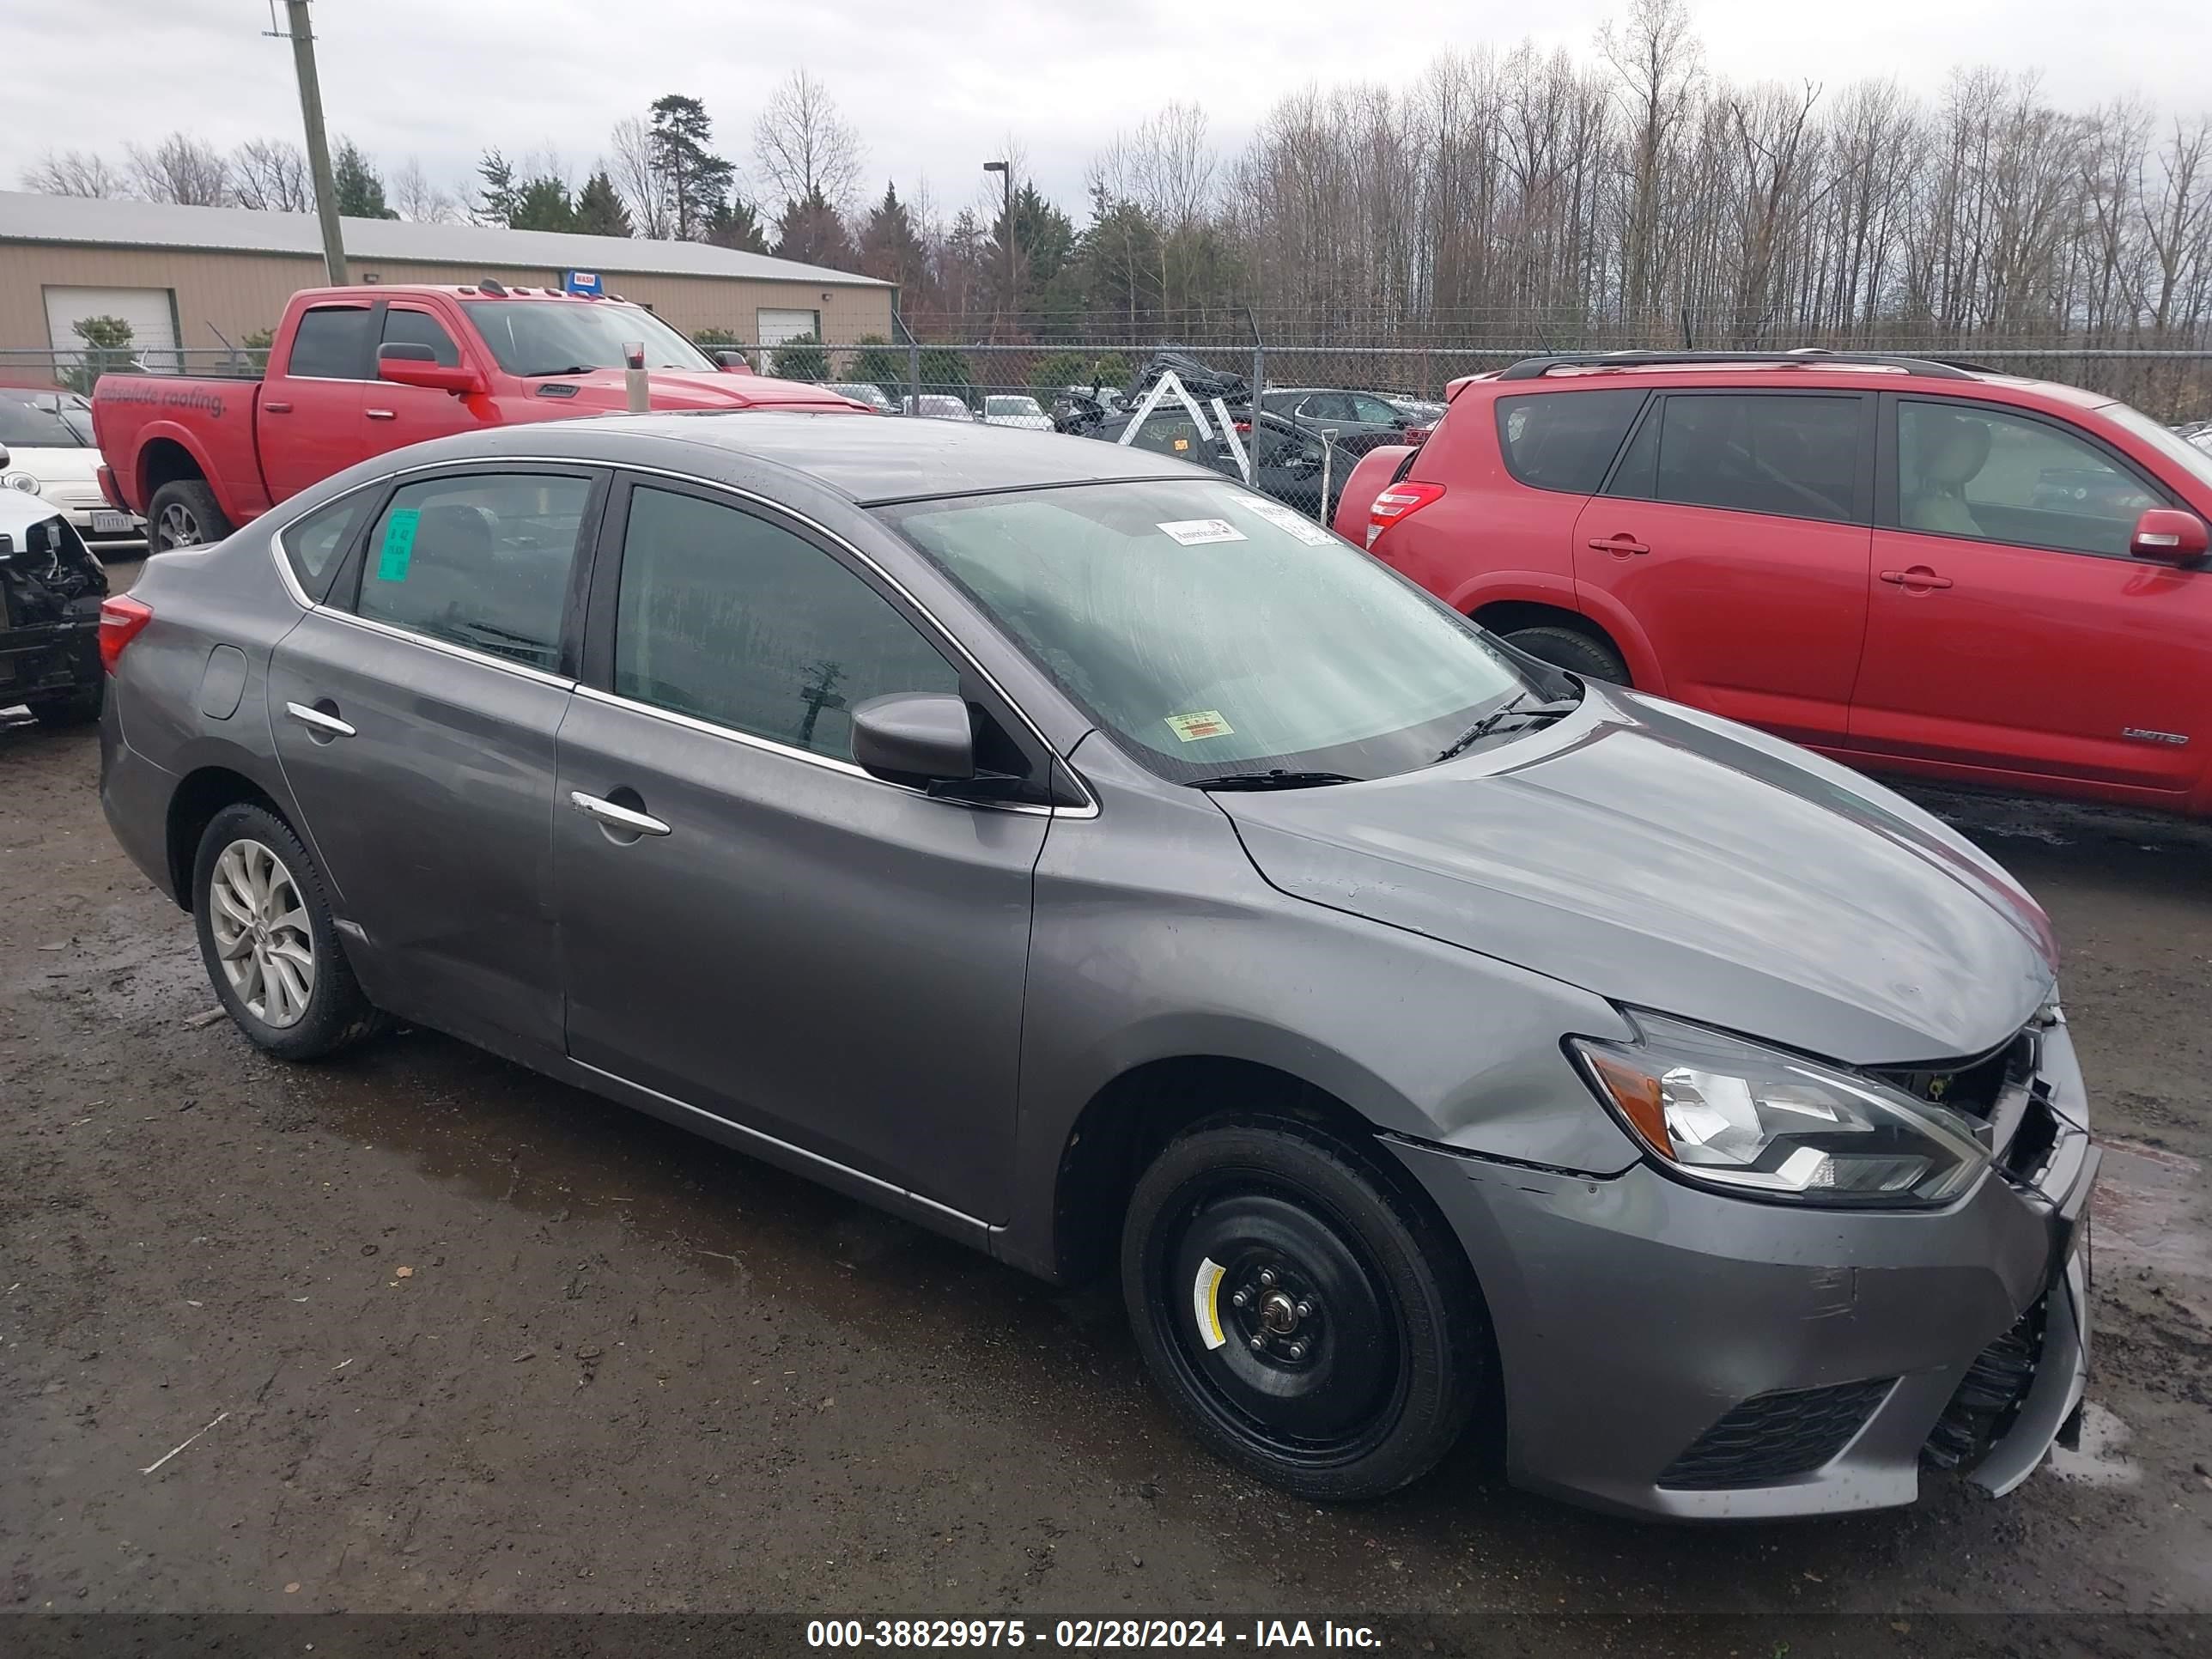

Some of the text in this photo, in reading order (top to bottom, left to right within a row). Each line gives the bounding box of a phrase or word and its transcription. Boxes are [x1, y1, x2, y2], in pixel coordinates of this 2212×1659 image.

[575, 274, 594, 283] WASH
[100, 381, 227, 418] absolute roofing.
[1174, 529, 1223, 540] American
[2123, 727, 2190, 744] LIMITED
